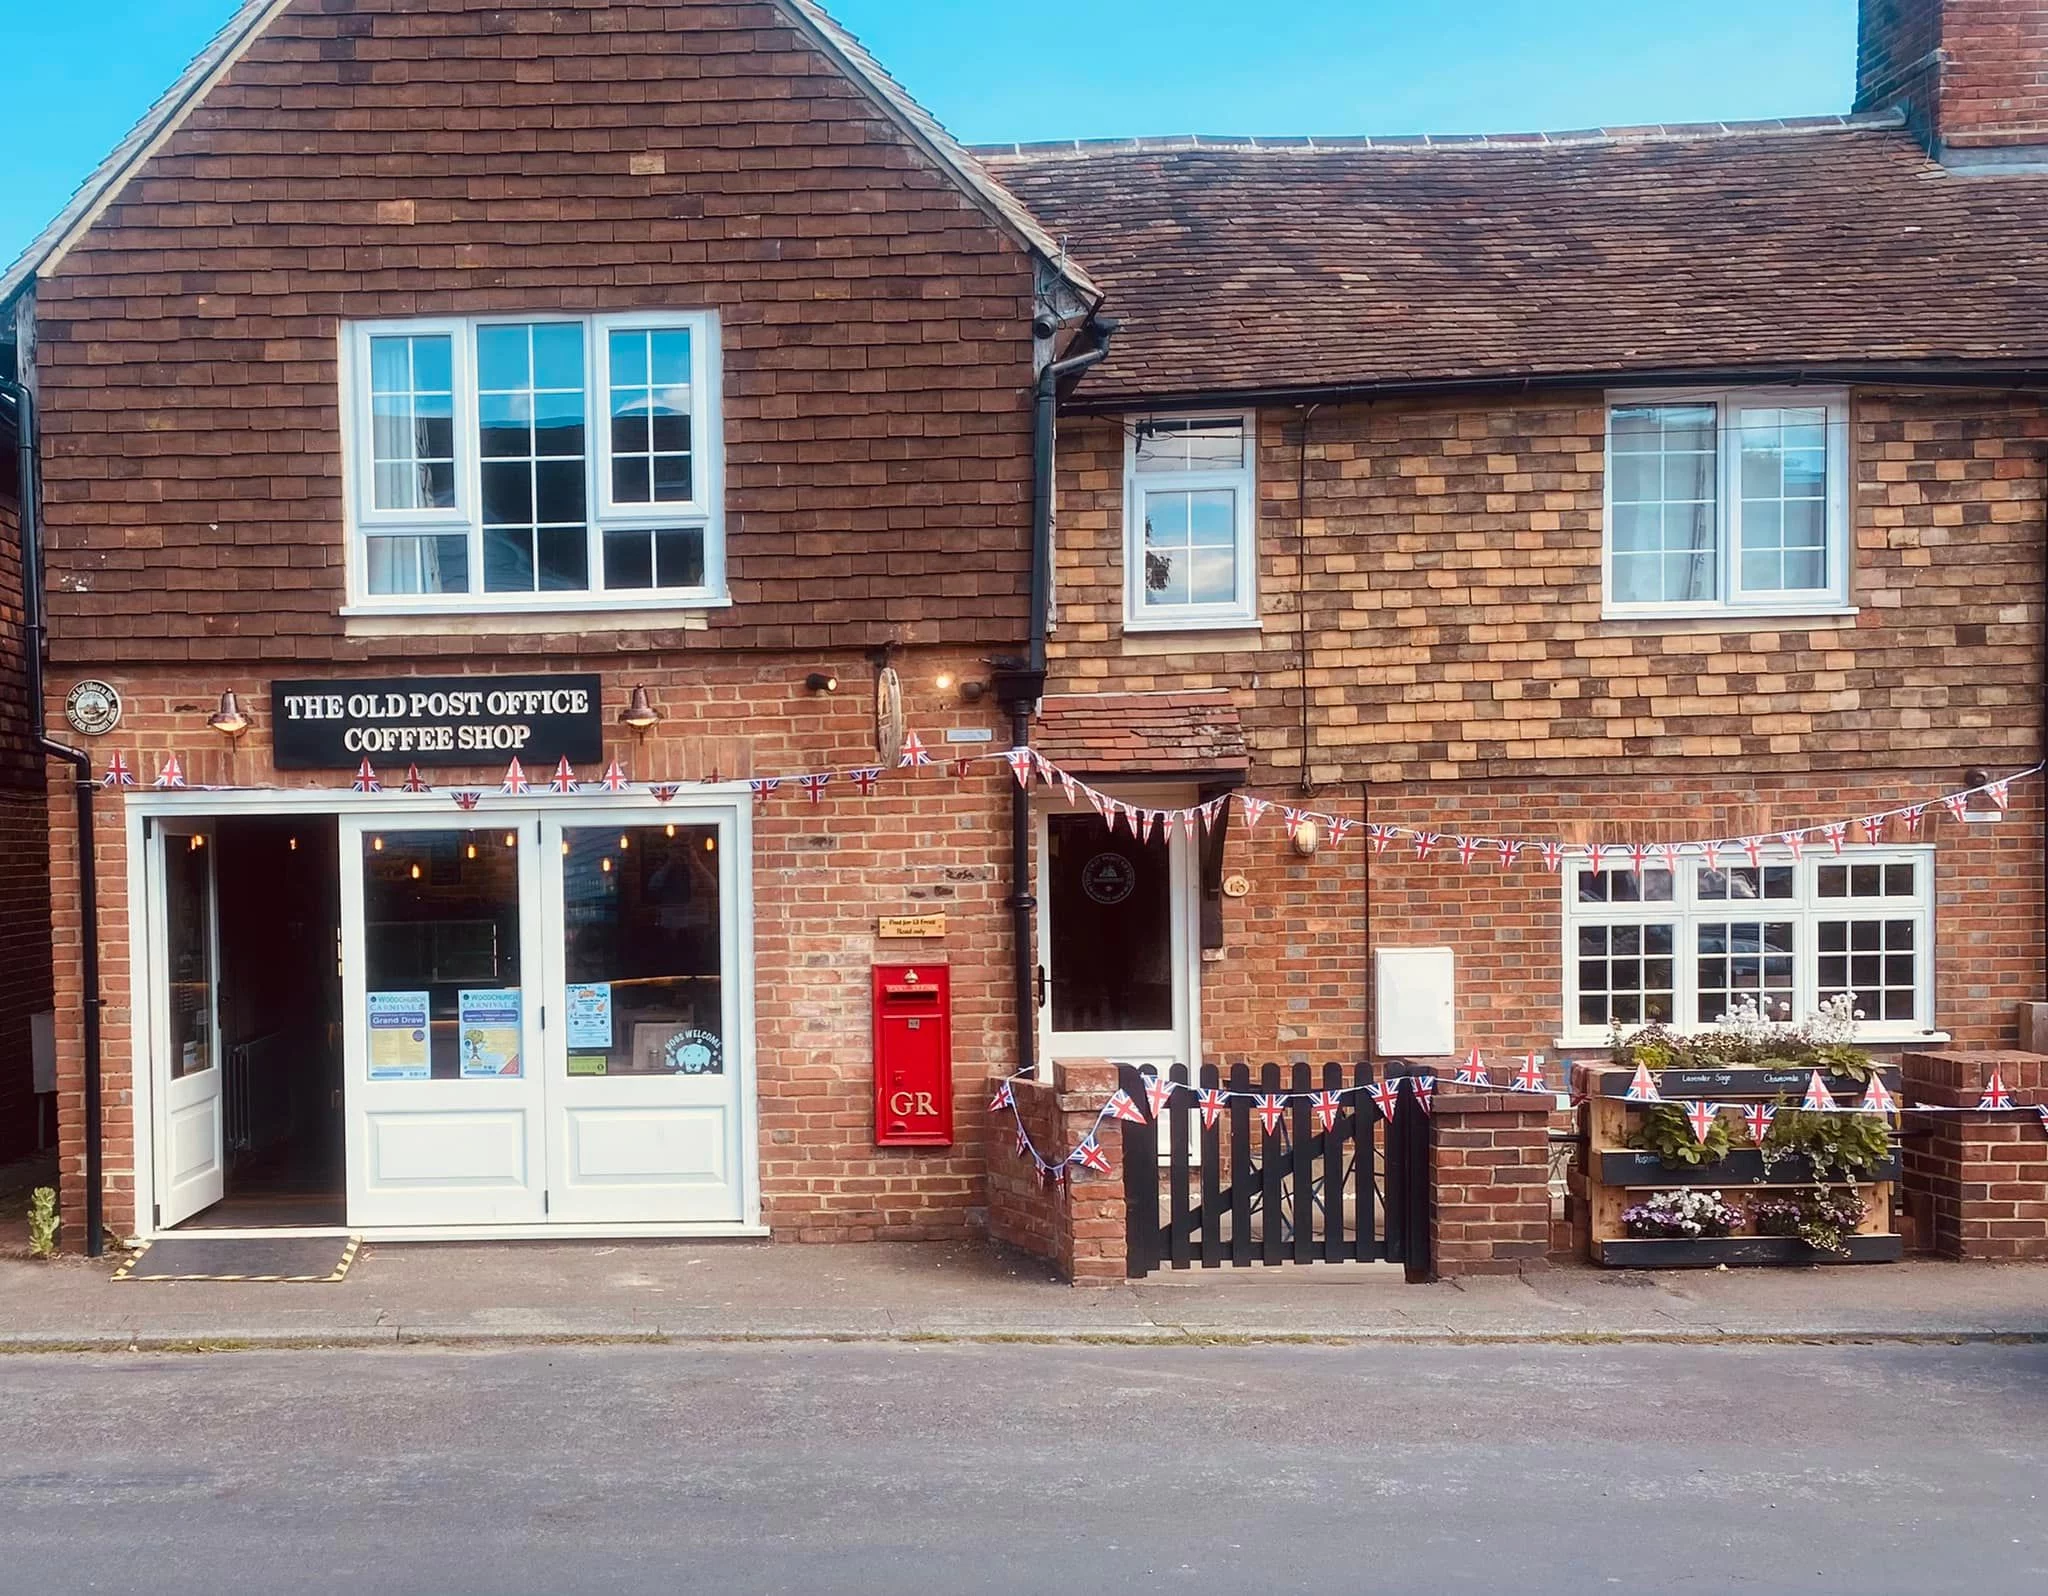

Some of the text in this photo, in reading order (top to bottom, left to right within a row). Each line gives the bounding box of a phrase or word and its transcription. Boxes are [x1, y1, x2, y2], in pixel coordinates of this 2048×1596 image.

[284, 689, 589, 720] THE OLD POST OFFICE
[344, 724, 531, 752] COFFEE SHOP
[372, 1016, 424, 1024] Grand Draw
[684, 1029, 721, 1049] WELCOME
[1682, 1073, 1711, 1082] Lavender
[1714, 1072, 1732, 1085] Sage
[890, 1091, 939, 1116] GR
